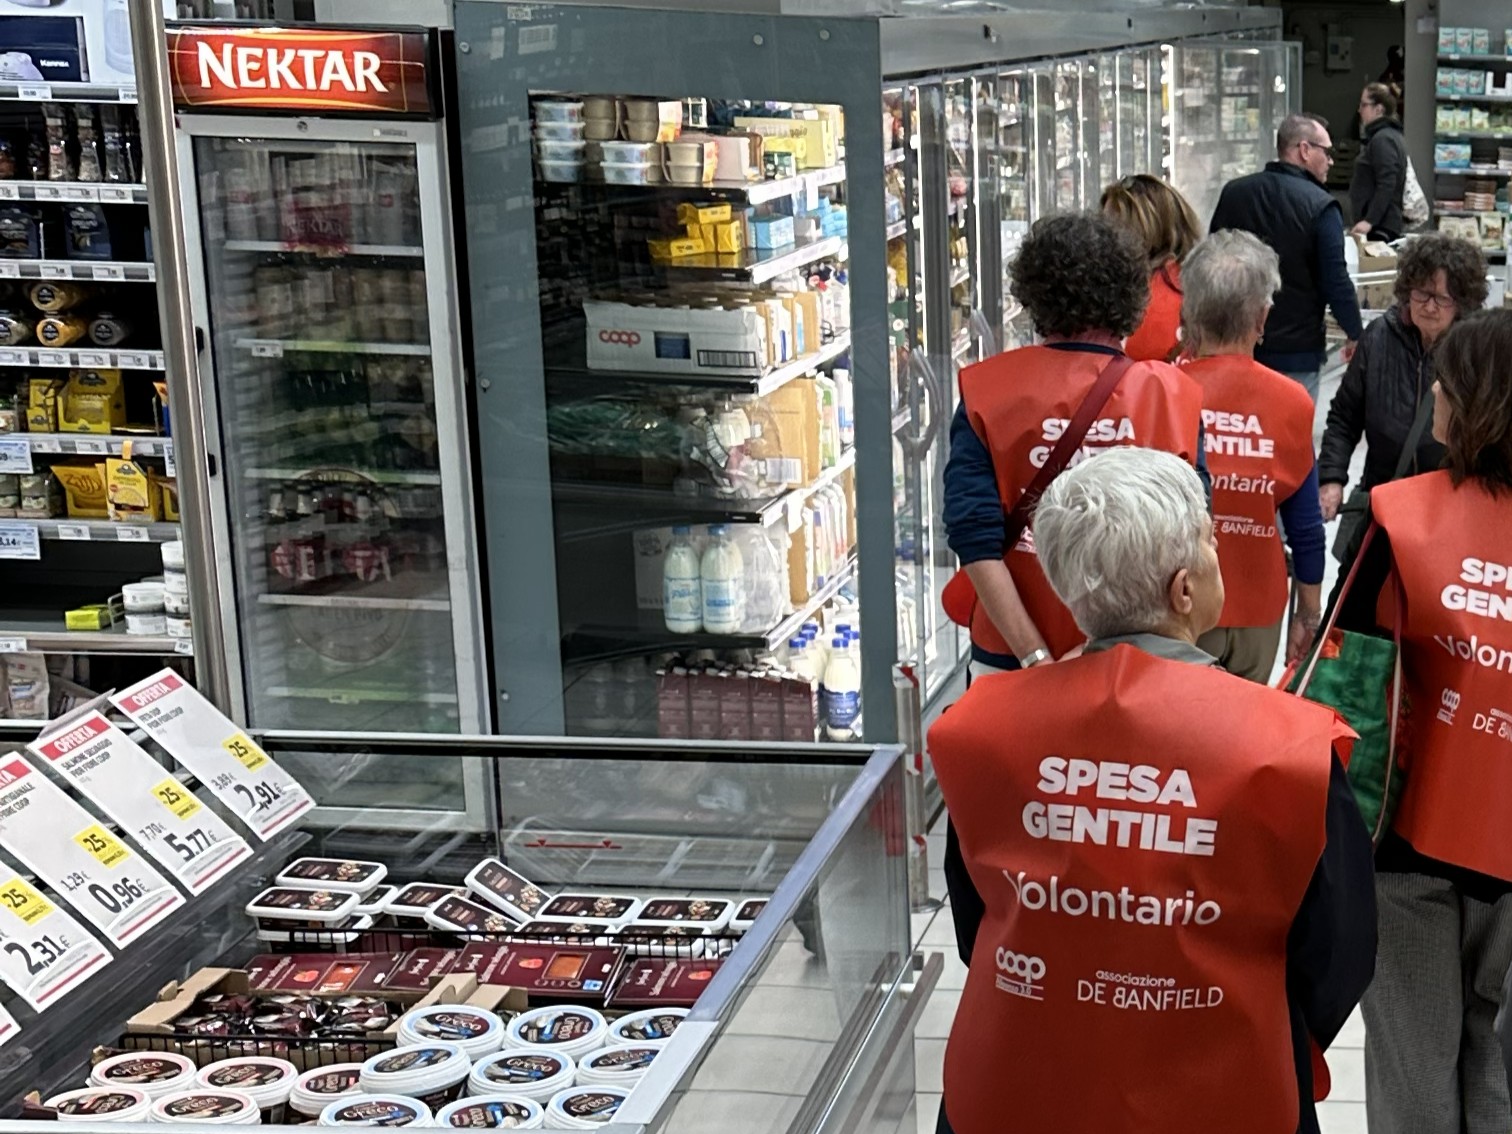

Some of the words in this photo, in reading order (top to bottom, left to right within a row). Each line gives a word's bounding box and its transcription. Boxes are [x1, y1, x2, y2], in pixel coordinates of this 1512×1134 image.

[196, 42, 389, 93] NEKTAR
[599, 329, 641, 348] coop
[1201, 409, 1263, 435] PESA
[1204, 433, 1274, 458] NTILE
[132, 683, 172, 706] OFFERTA
[1472, 713, 1494, 734] DE
[54, 724, 97, 753] OFFERTA
[1037, 756, 1198, 808] SPESA
[1022, 801, 1218, 856] GENTILE
[1002, 869, 1221, 927] Volontario
[995, 946, 1046, 984] coop
[1095, 969, 1176, 988] associazione
[1077, 979, 1106, 1005] DE
[1113, 986, 1224, 1011] BANFIELD
[435, 1014, 481, 1031] Greco
[507, 1058, 553, 1073] Greco
